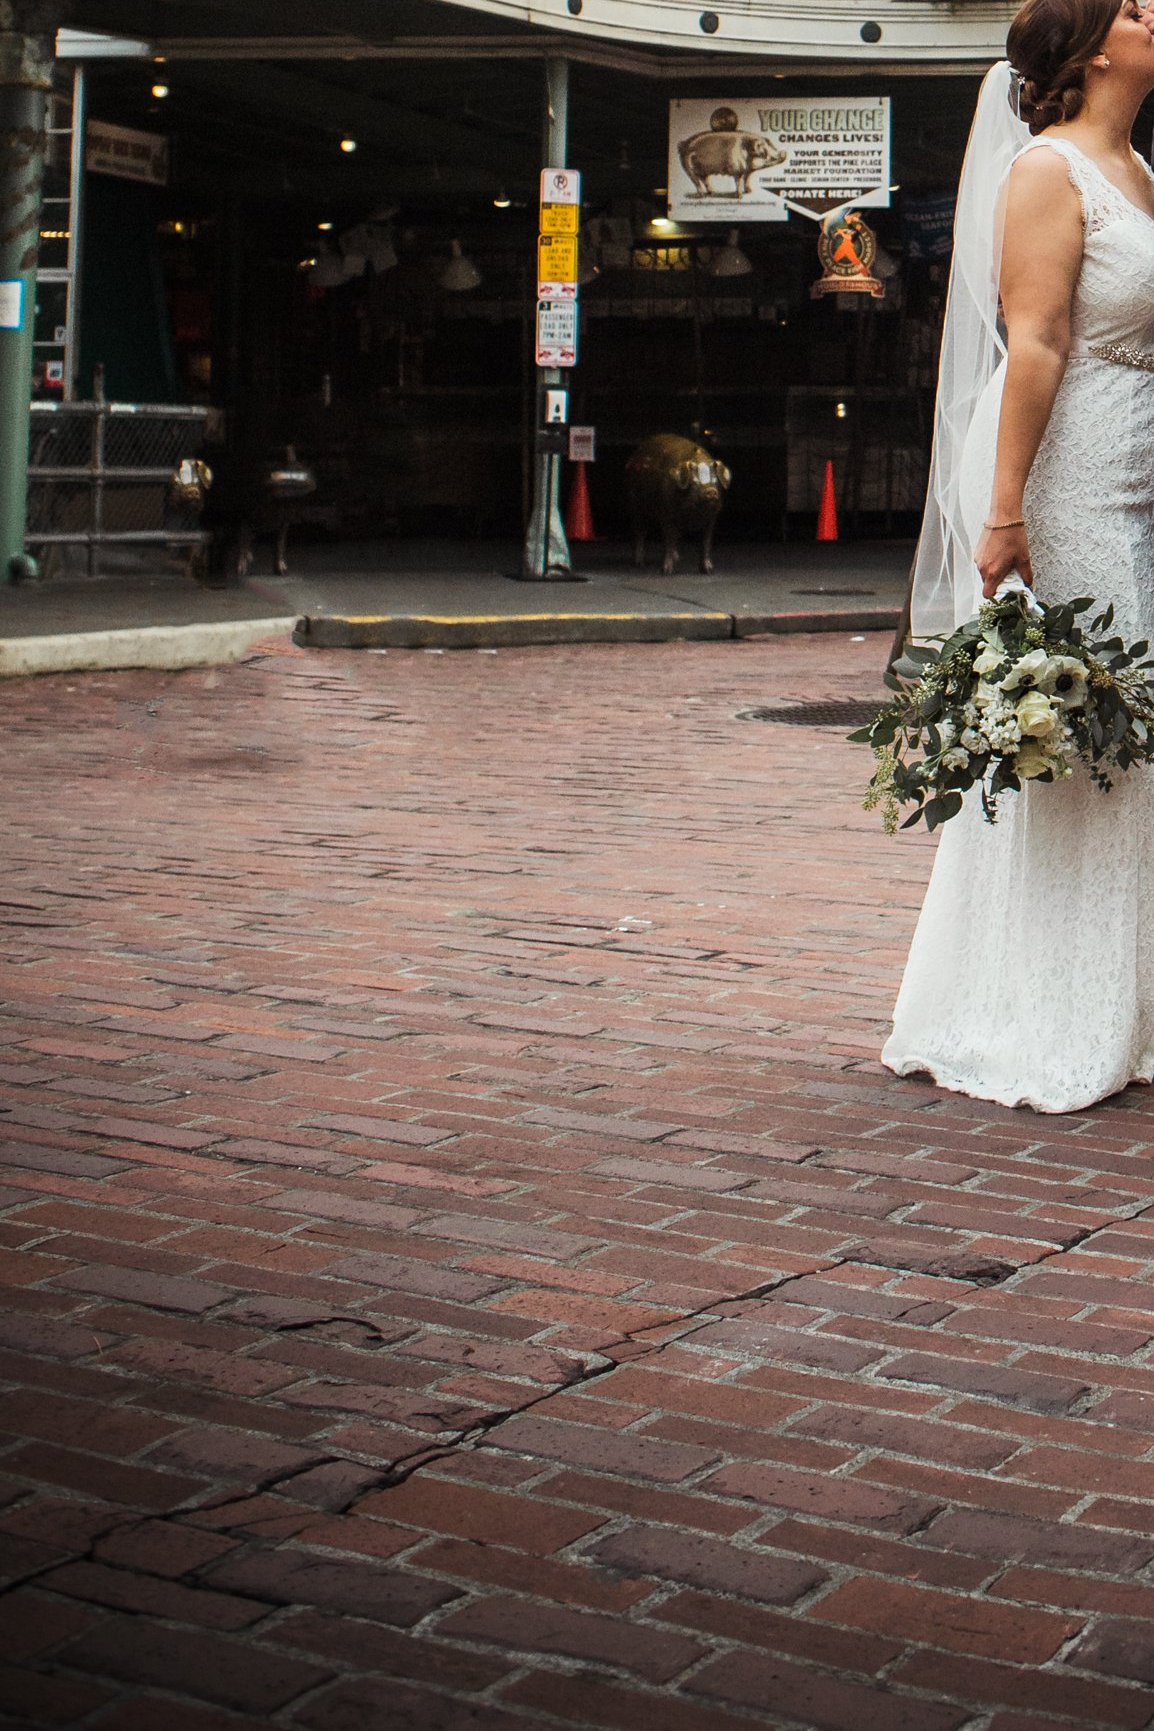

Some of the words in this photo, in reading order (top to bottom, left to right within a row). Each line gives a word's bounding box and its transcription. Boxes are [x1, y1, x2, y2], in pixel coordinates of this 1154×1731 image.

[758, 108, 808, 132] YOUR
[809, 108, 884, 132] CHANGE
[778, 134, 840, 143] CHANGES
[843, 134, 883, 142] LIVES!
[779, 189, 826, 199] DONATE
[828, 189, 862, 199] HERE!
